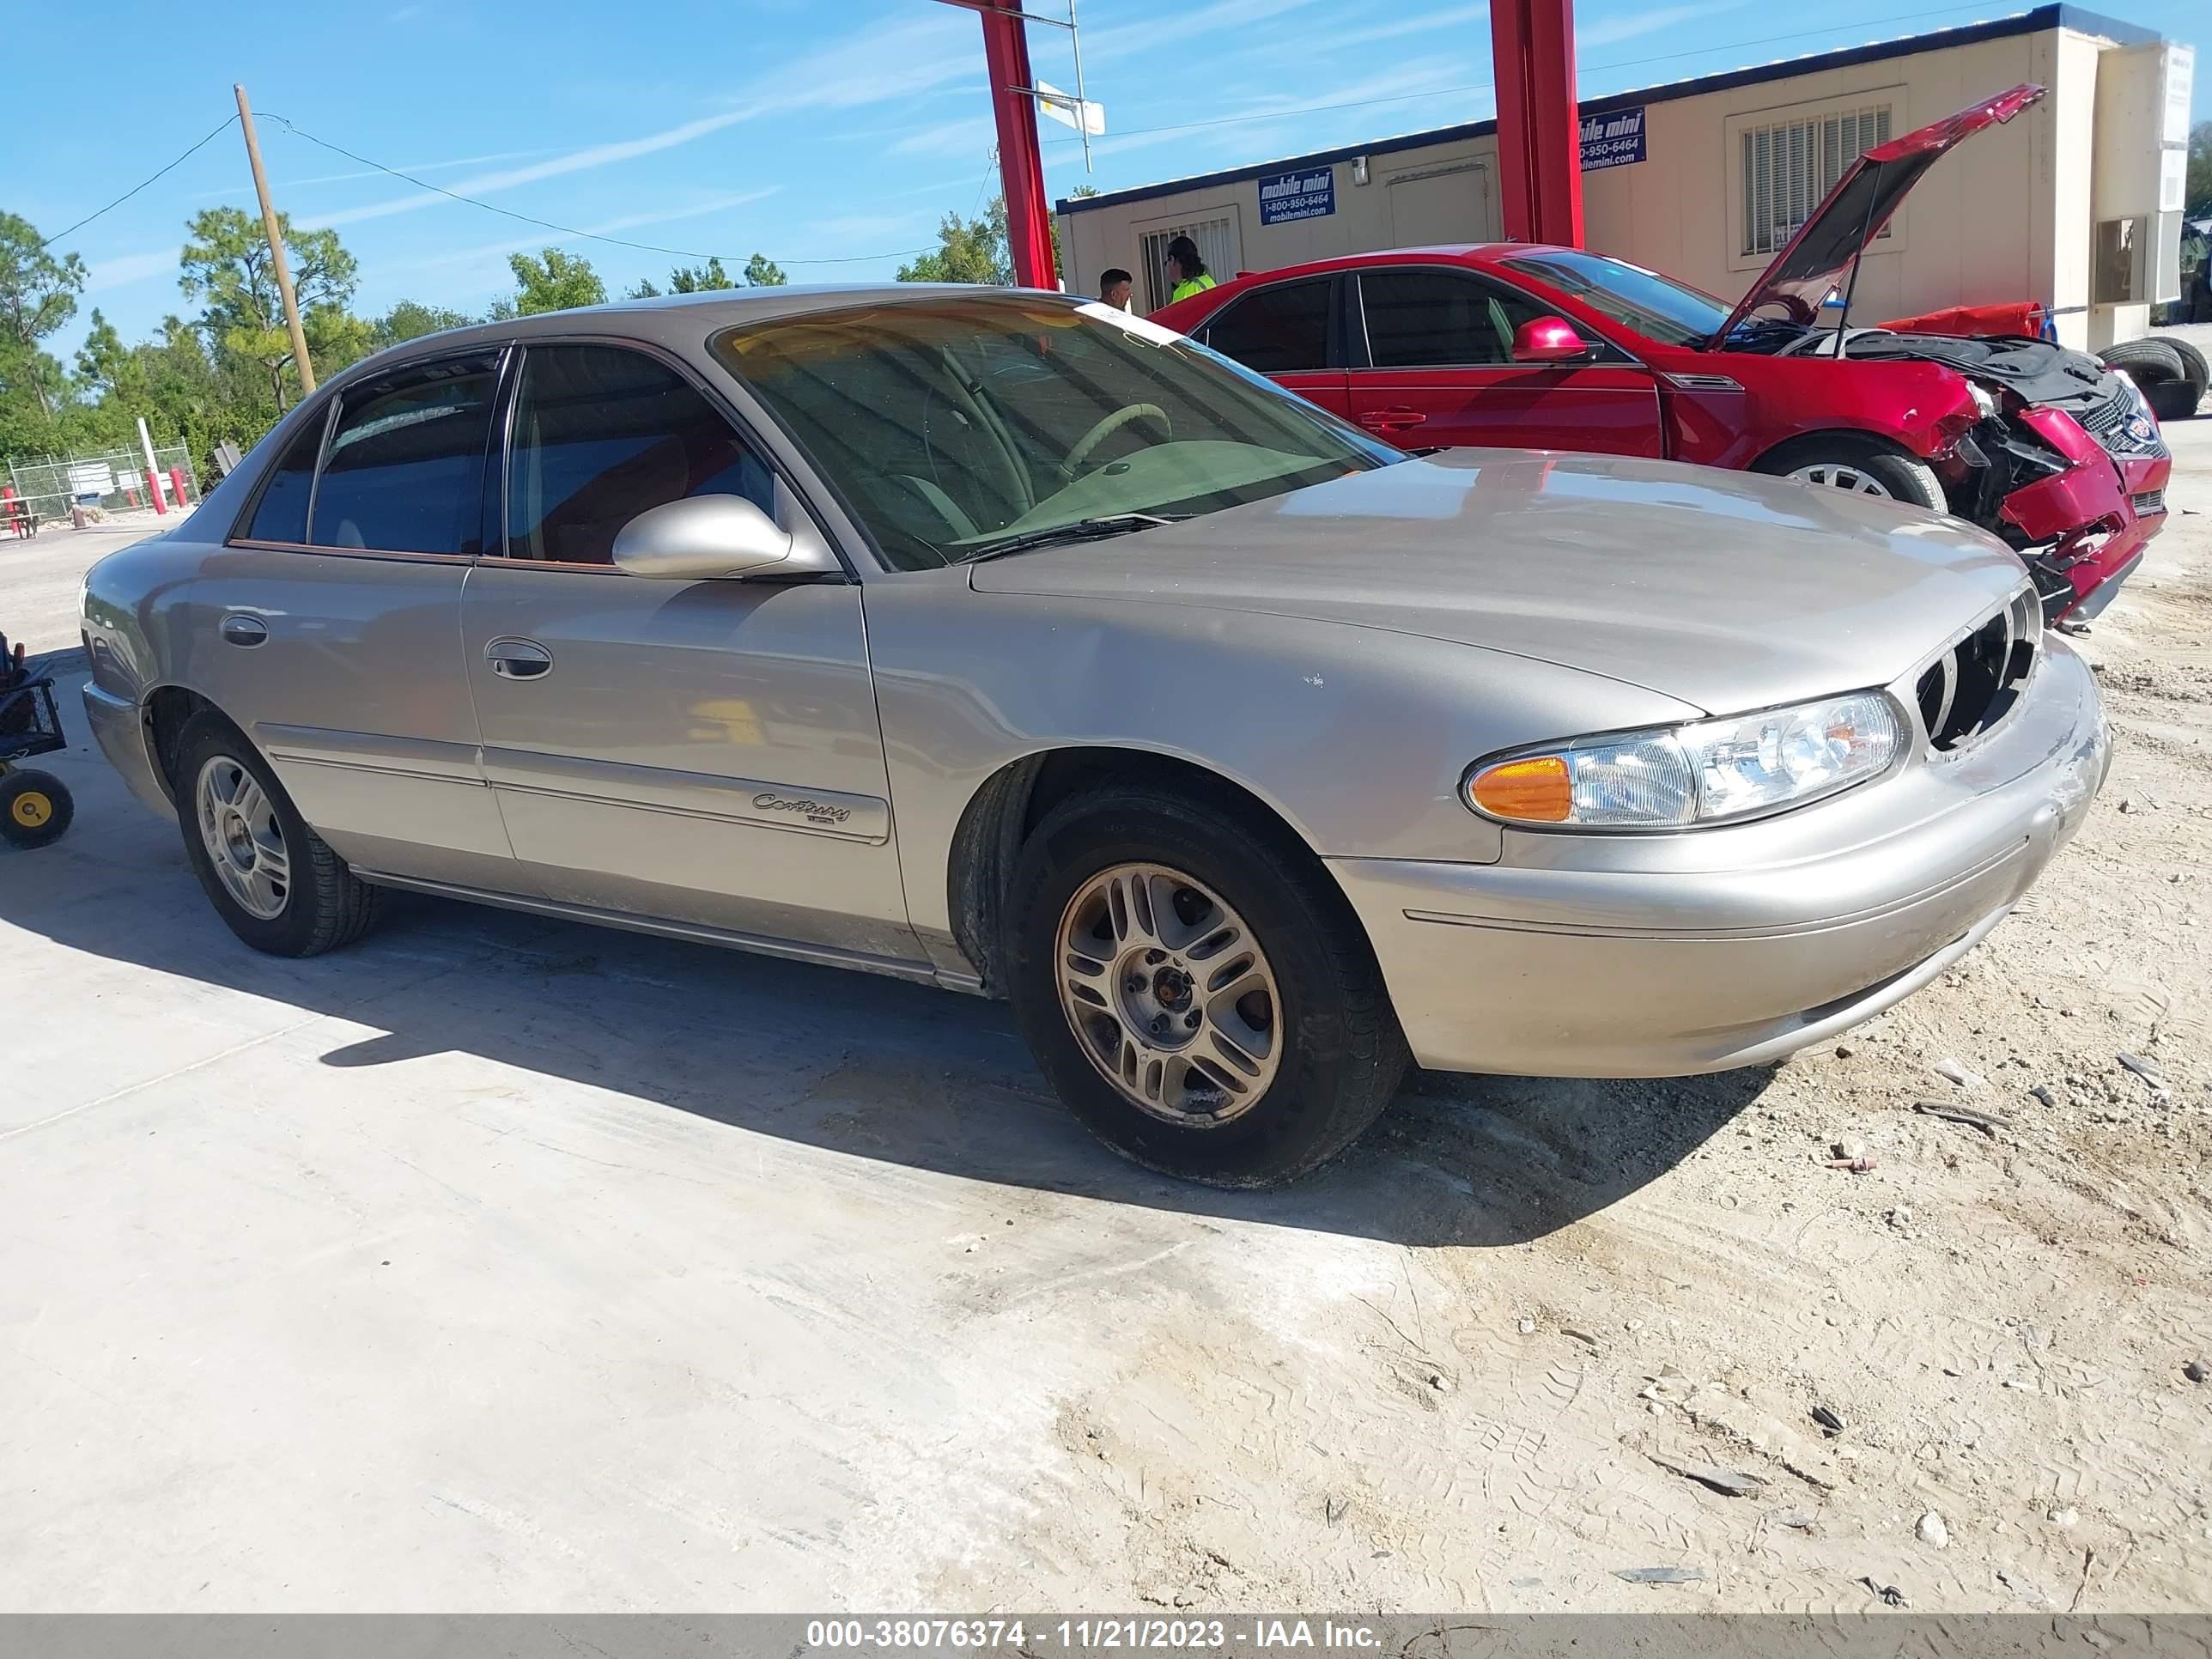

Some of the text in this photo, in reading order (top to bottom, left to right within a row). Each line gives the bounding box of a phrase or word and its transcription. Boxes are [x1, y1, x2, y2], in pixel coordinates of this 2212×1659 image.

[1605, 113, 1642, 138] mini
[1261, 172, 1331, 199] mobile mini
[1265, 194, 1328, 213] 1-800-950-6464
[1270, 207, 1326, 222] mobilemini.com
[753, 793, 851, 822] Century
